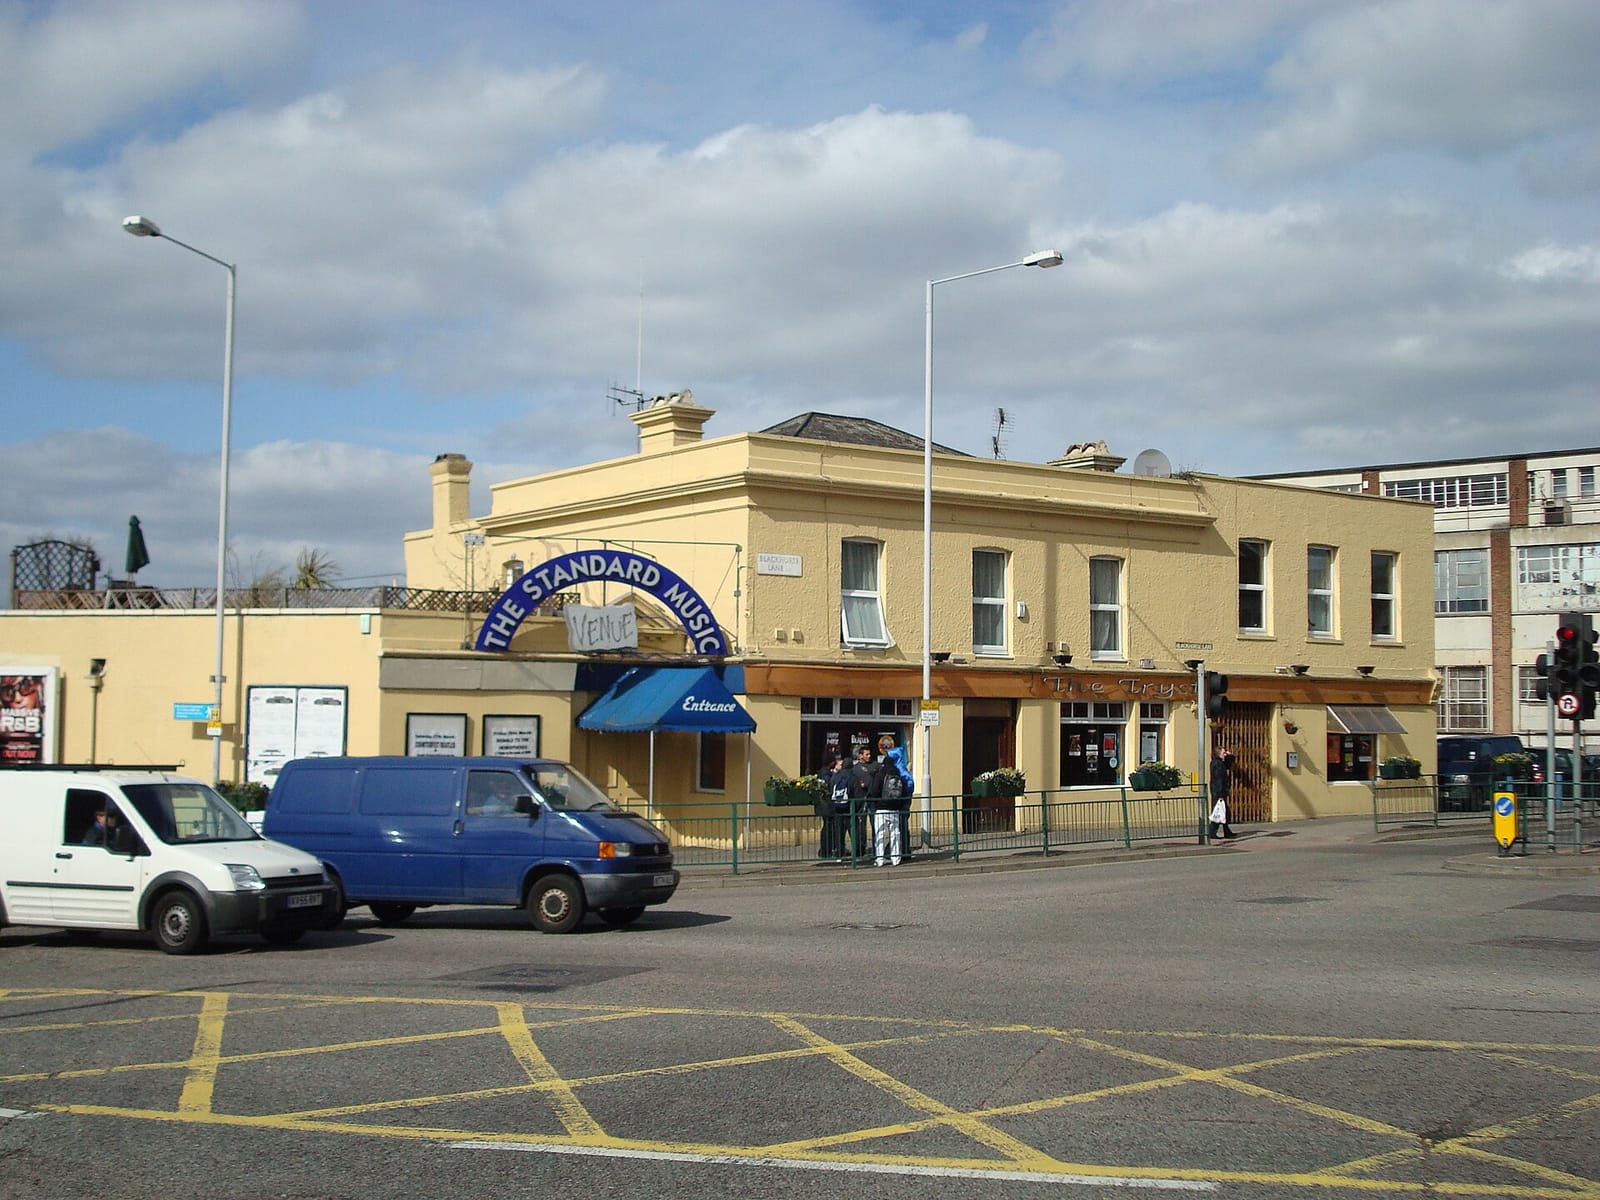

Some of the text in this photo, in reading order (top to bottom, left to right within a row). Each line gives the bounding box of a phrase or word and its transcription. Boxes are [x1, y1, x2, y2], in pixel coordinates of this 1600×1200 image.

[484, 554, 721, 654] THE STANDARD MUSIC
[573, 610, 634, 646] VENUE
[1043, 677, 1105, 694] The
[682, 695, 737, 712] Entrance
[0, 716, 41, 733] R&B
